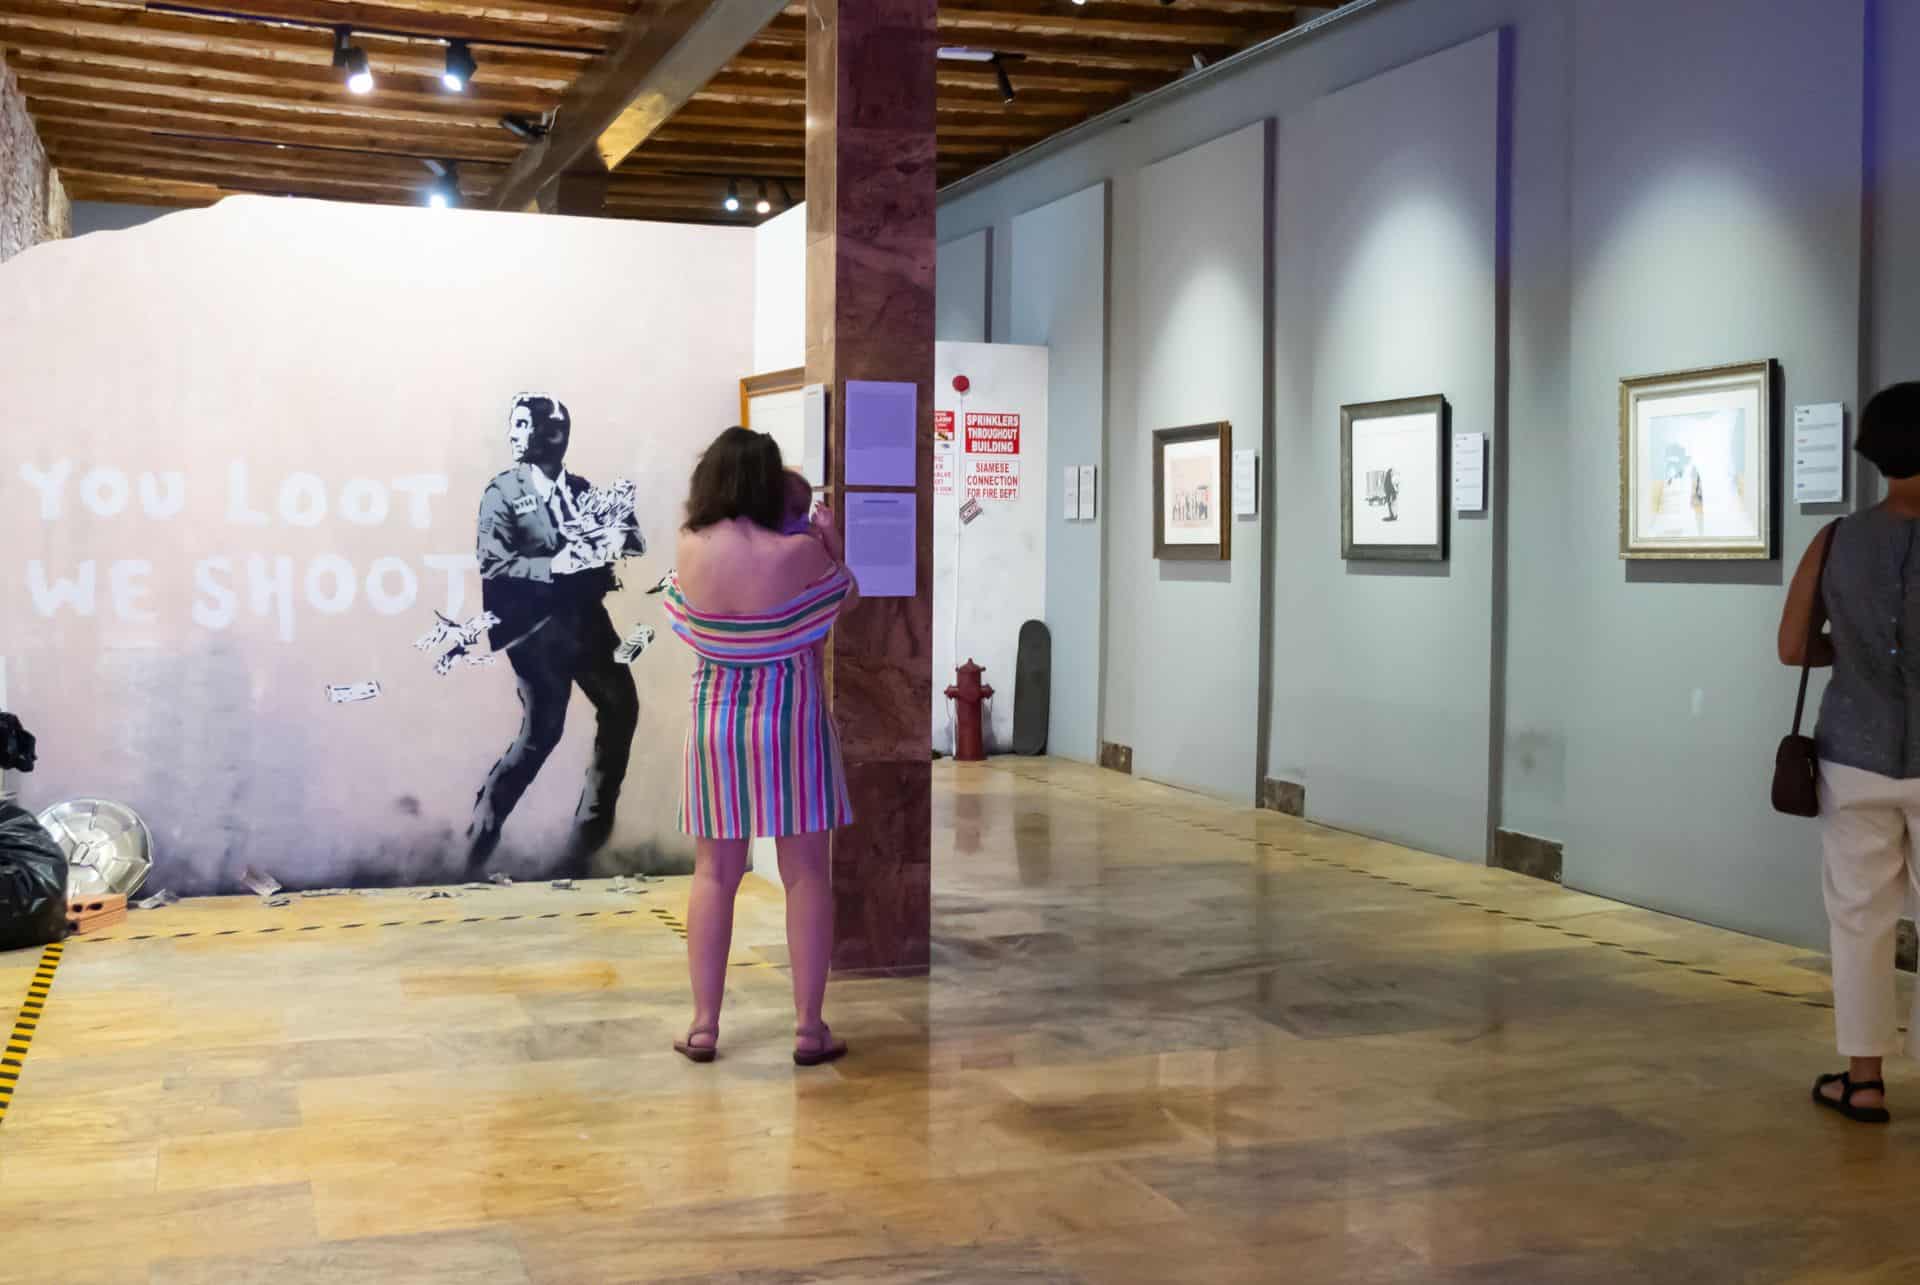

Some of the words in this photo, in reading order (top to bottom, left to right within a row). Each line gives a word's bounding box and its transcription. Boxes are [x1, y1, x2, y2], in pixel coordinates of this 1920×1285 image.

[966, 413, 1019, 426] SPRINKLERS
[967, 427, 1018, 440] THROUGHOUT
[971, 440, 1014, 453] BUILDING
[975, 462, 1010, 473] SIAMESE
[966, 475, 1018, 487] CONNECTION
[19, 460, 187, 521] YOU
[223, 457, 450, 529] LOOT
[967, 488, 981, 499] FOR
[982, 488, 998, 499] FIRE
[25, 558, 156, 622] WE
[191, 552, 481, 643] SHOOT
